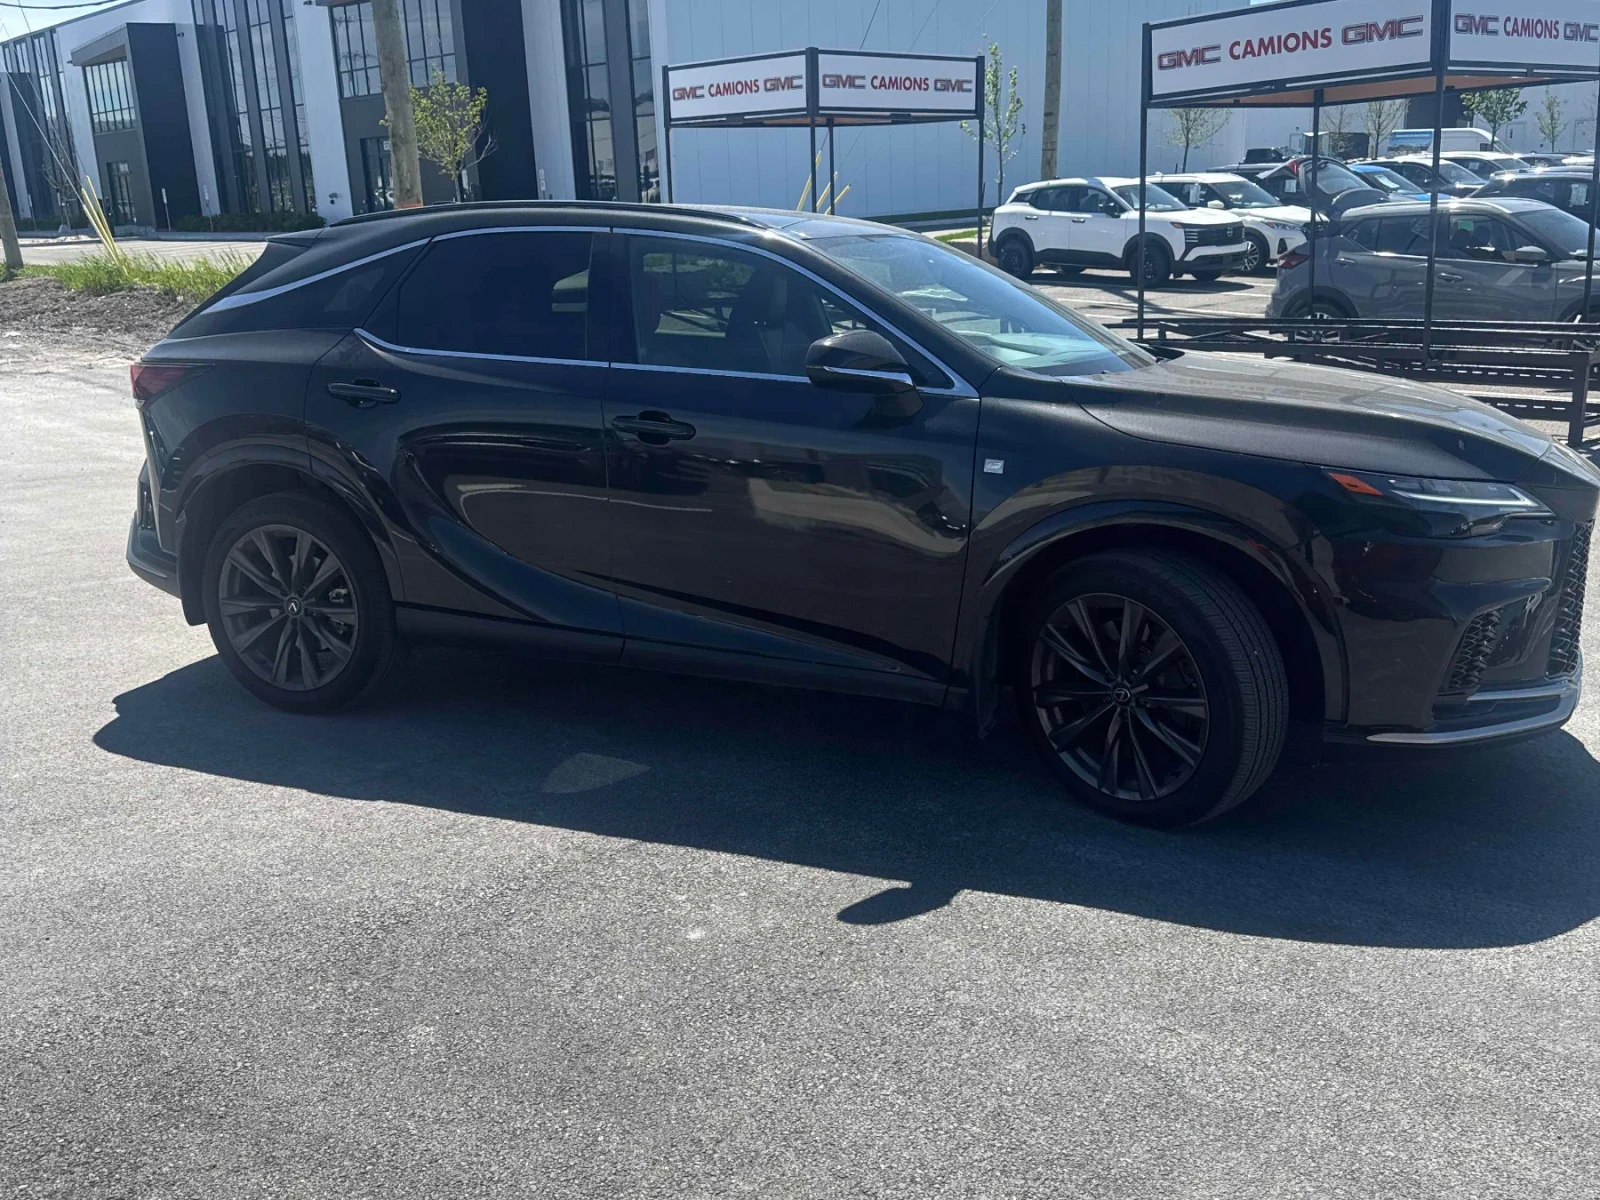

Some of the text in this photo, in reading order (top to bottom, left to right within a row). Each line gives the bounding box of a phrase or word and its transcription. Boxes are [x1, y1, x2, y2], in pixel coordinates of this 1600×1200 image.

[1454, 13, 1599, 43] GMC CAMIONS GMC
[1157, 15, 1424, 71] GMC CAMIONS GMC
[672, 74, 803, 101] GMC CAMIONS GMC
[822, 73, 973, 93] GMC CAMIONS GMC
